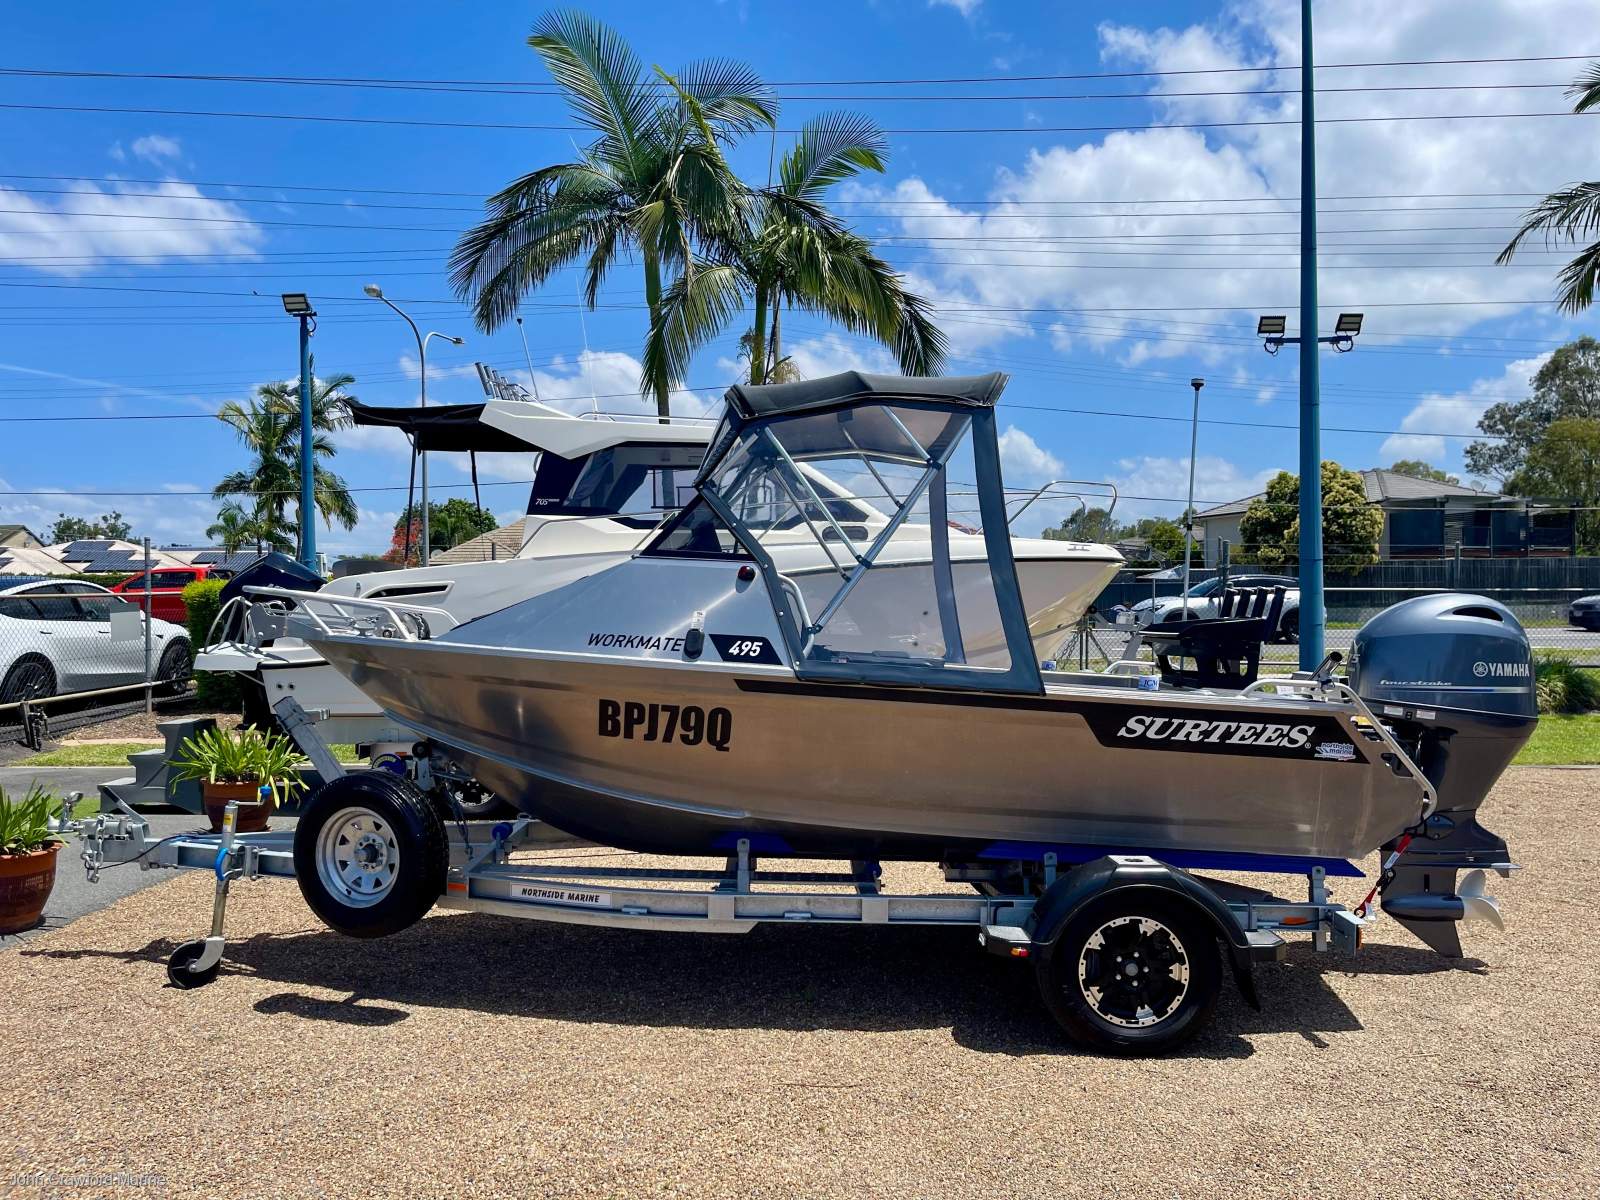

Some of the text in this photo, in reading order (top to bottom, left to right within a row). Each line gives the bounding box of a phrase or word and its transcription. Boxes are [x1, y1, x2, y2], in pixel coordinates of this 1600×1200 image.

[535, 498, 549, 506] 705
[587, 633, 686, 652] WORKMATE
[728, 640, 763, 657] 495
[1488, 662, 1530, 677] YAMAHA
[598, 698, 733, 752] BPJ79Q
[1116, 715, 1316, 748] SURTEES
[521, 887, 600, 903] NORTHSIDE MARINE
